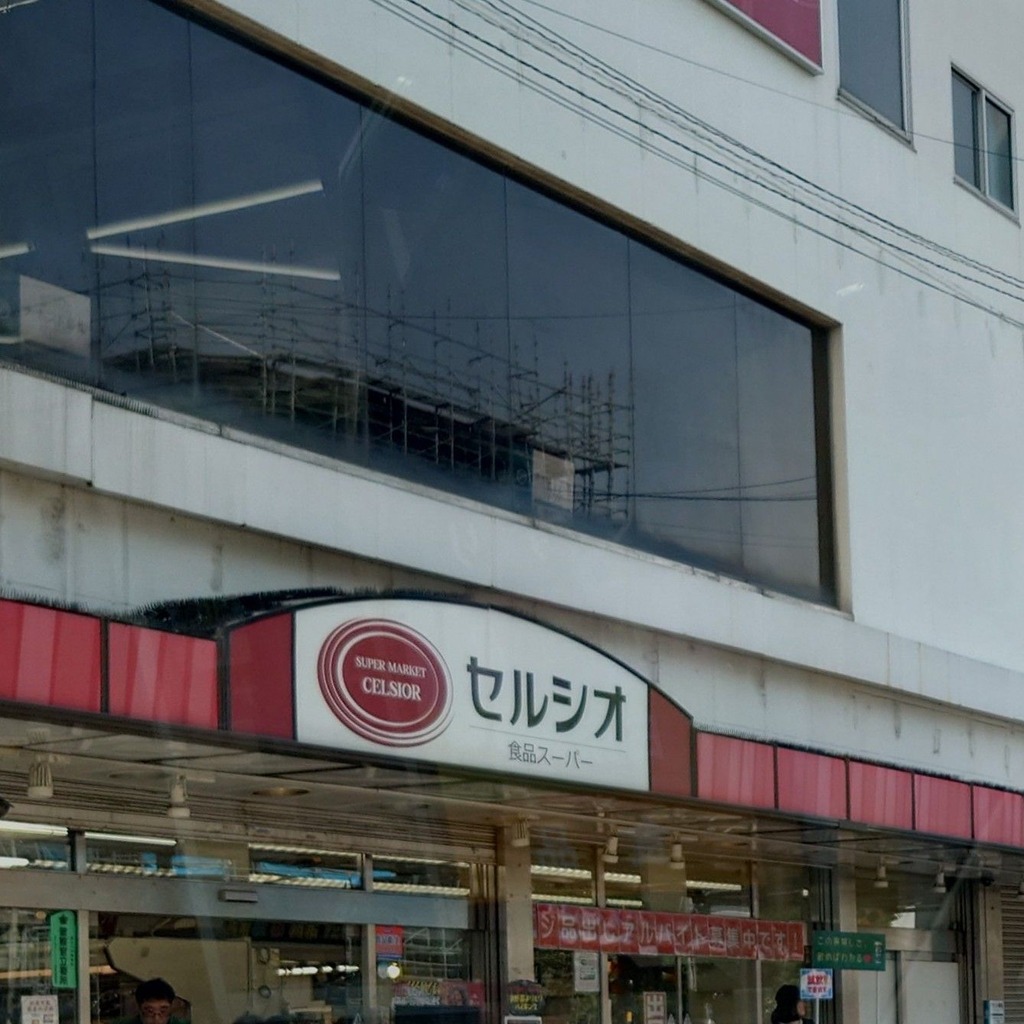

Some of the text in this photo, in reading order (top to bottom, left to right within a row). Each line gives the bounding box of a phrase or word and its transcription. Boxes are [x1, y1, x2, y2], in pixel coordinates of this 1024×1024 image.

[355, 655, 427, 679] SUPER MARKET
[362, 676, 422, 701] CELSIOR
[466, 656, 627, 742] セルシオ
[508, 740, 594, 769] 食品スーパー
